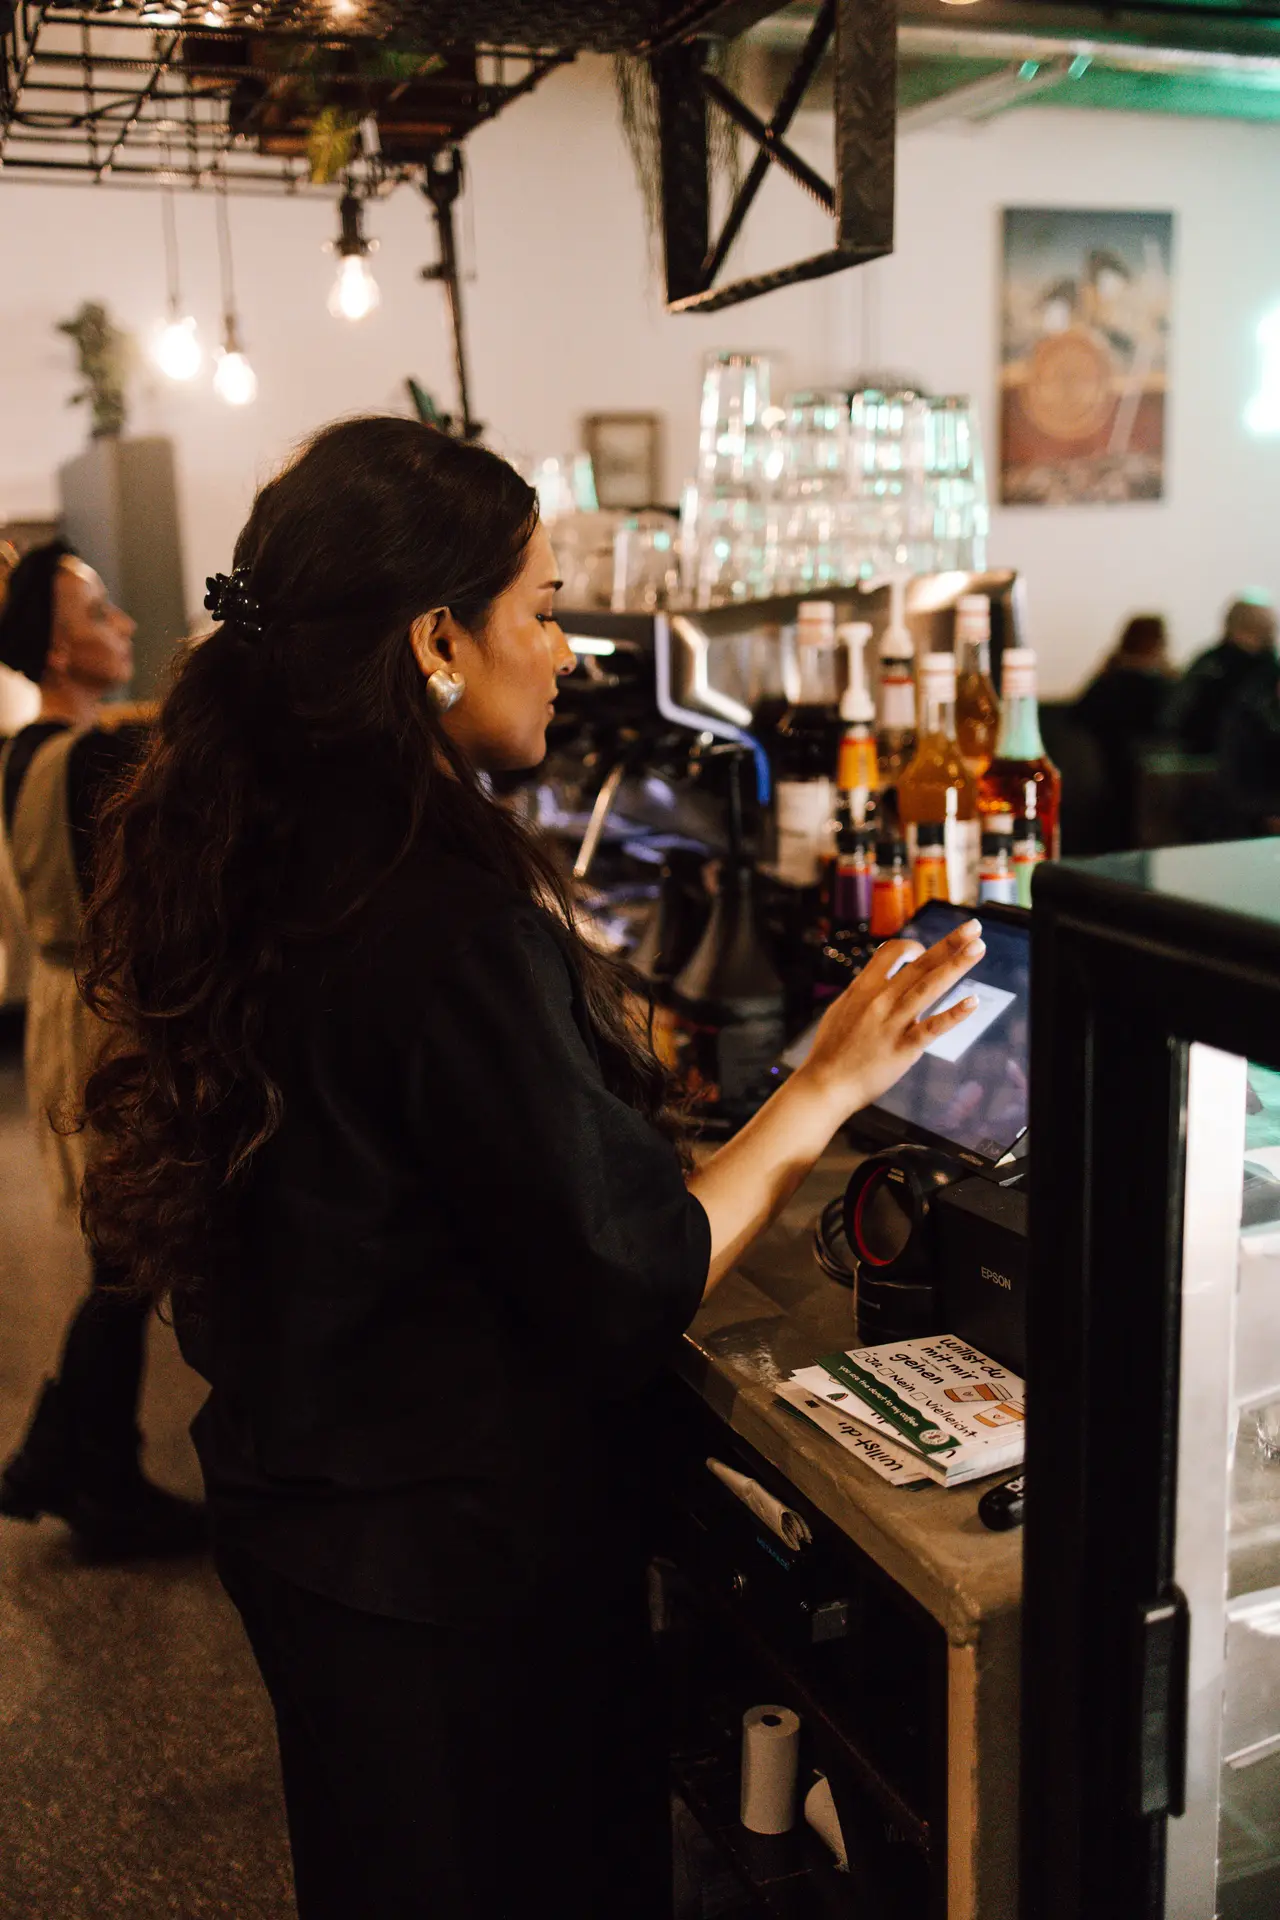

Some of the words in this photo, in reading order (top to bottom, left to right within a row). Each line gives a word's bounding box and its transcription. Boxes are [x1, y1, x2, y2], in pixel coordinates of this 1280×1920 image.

[981, 1266, 1011, 1290] EPSON
[889, 1353, 944, 1384] gehen
[921, 1347, 954, 1363] mit
[946, 1363, 979, 1380] mir
[980, 1365, 1006, 1380] du
[889, 1374, 916, 1392] Nein
[926, 1400, 978, 1438] Vielleicht
[838, 1422, 862, 1437] du
